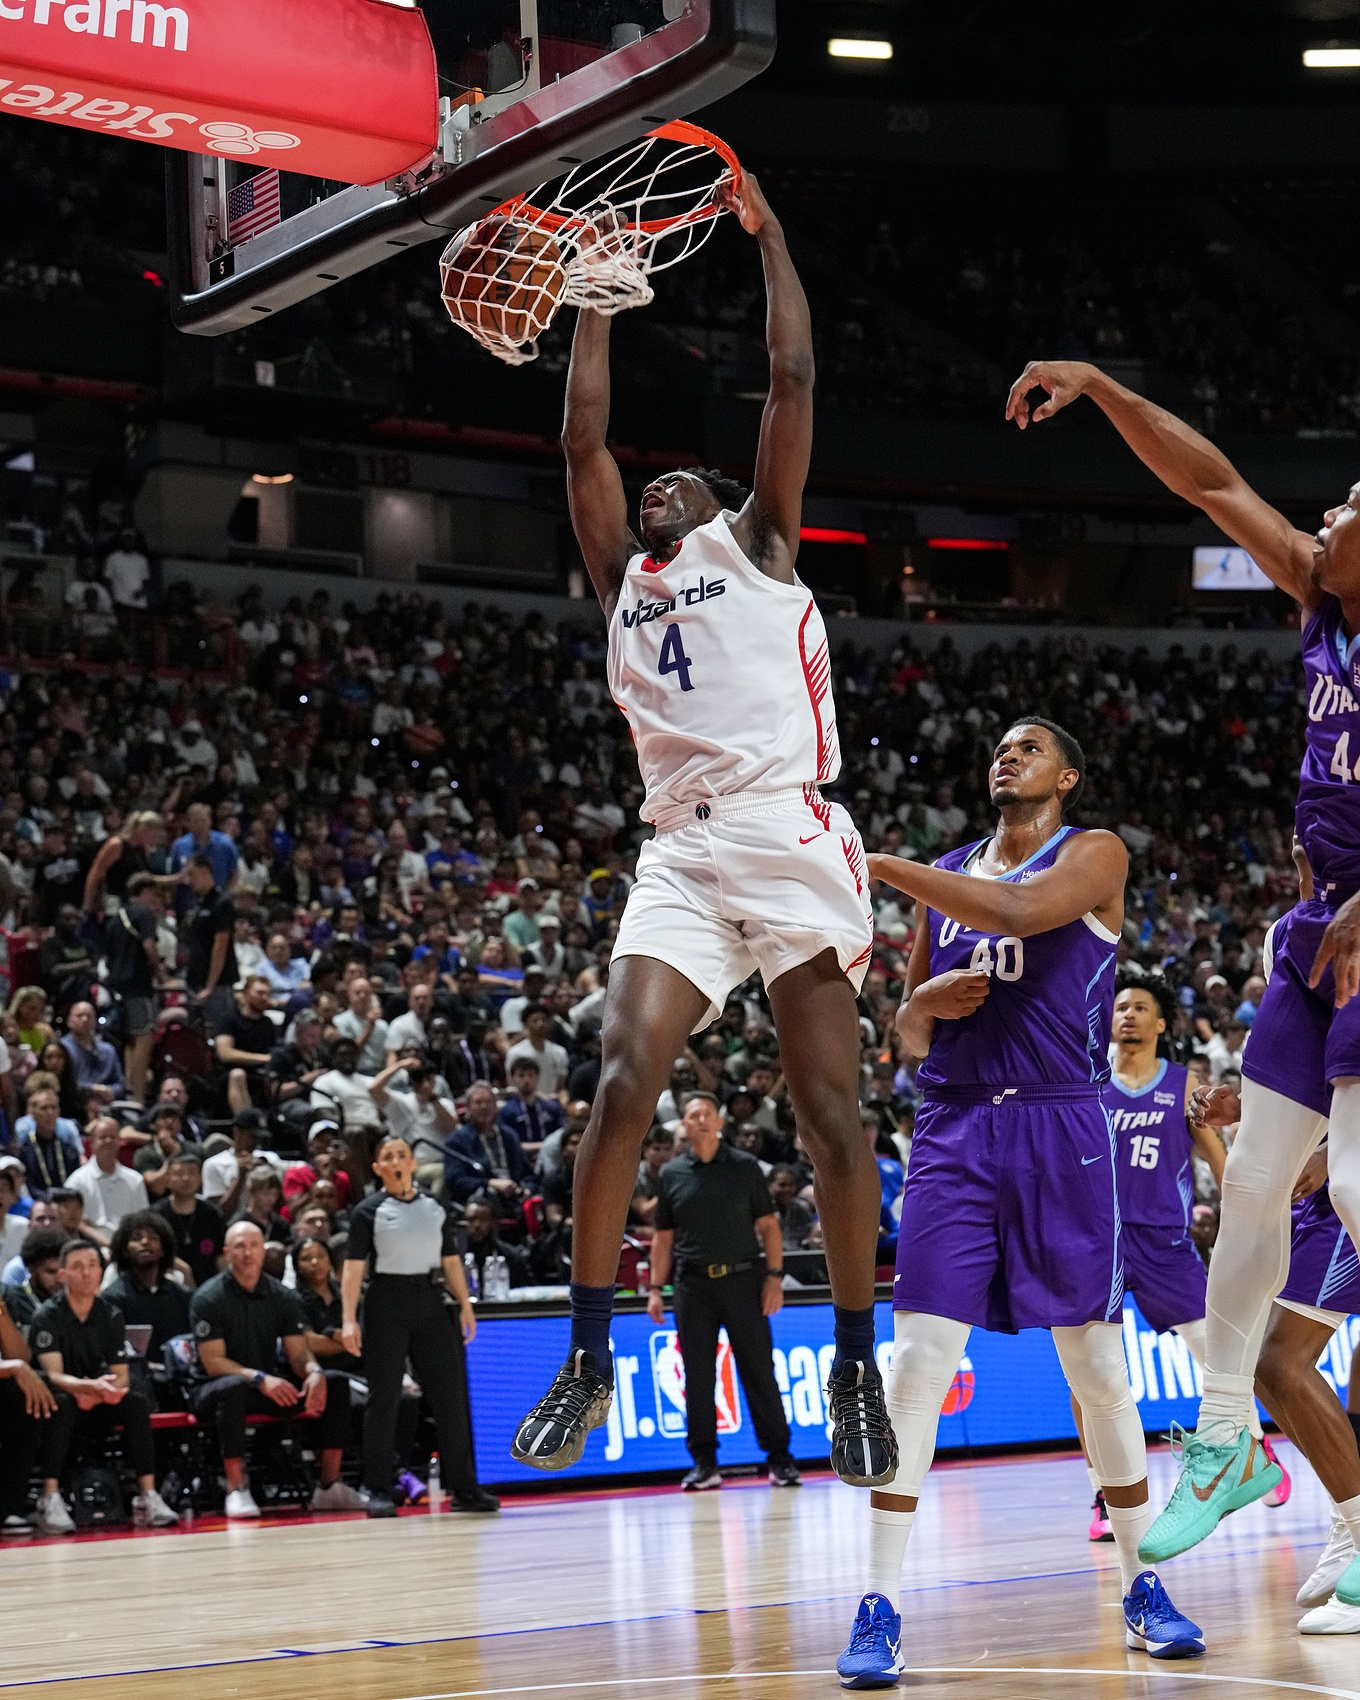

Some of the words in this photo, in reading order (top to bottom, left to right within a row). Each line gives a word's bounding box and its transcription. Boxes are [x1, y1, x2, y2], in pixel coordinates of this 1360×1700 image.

[219, 261, 225, 275] 5
[621, 576, 728, 628] wizards
[658, 622, 695, 692] 4
[971, 938, 1023, 982] 40
[1130, 1135, 1160, 1170] 15
[604, 1337, 656, 1461] jr.
